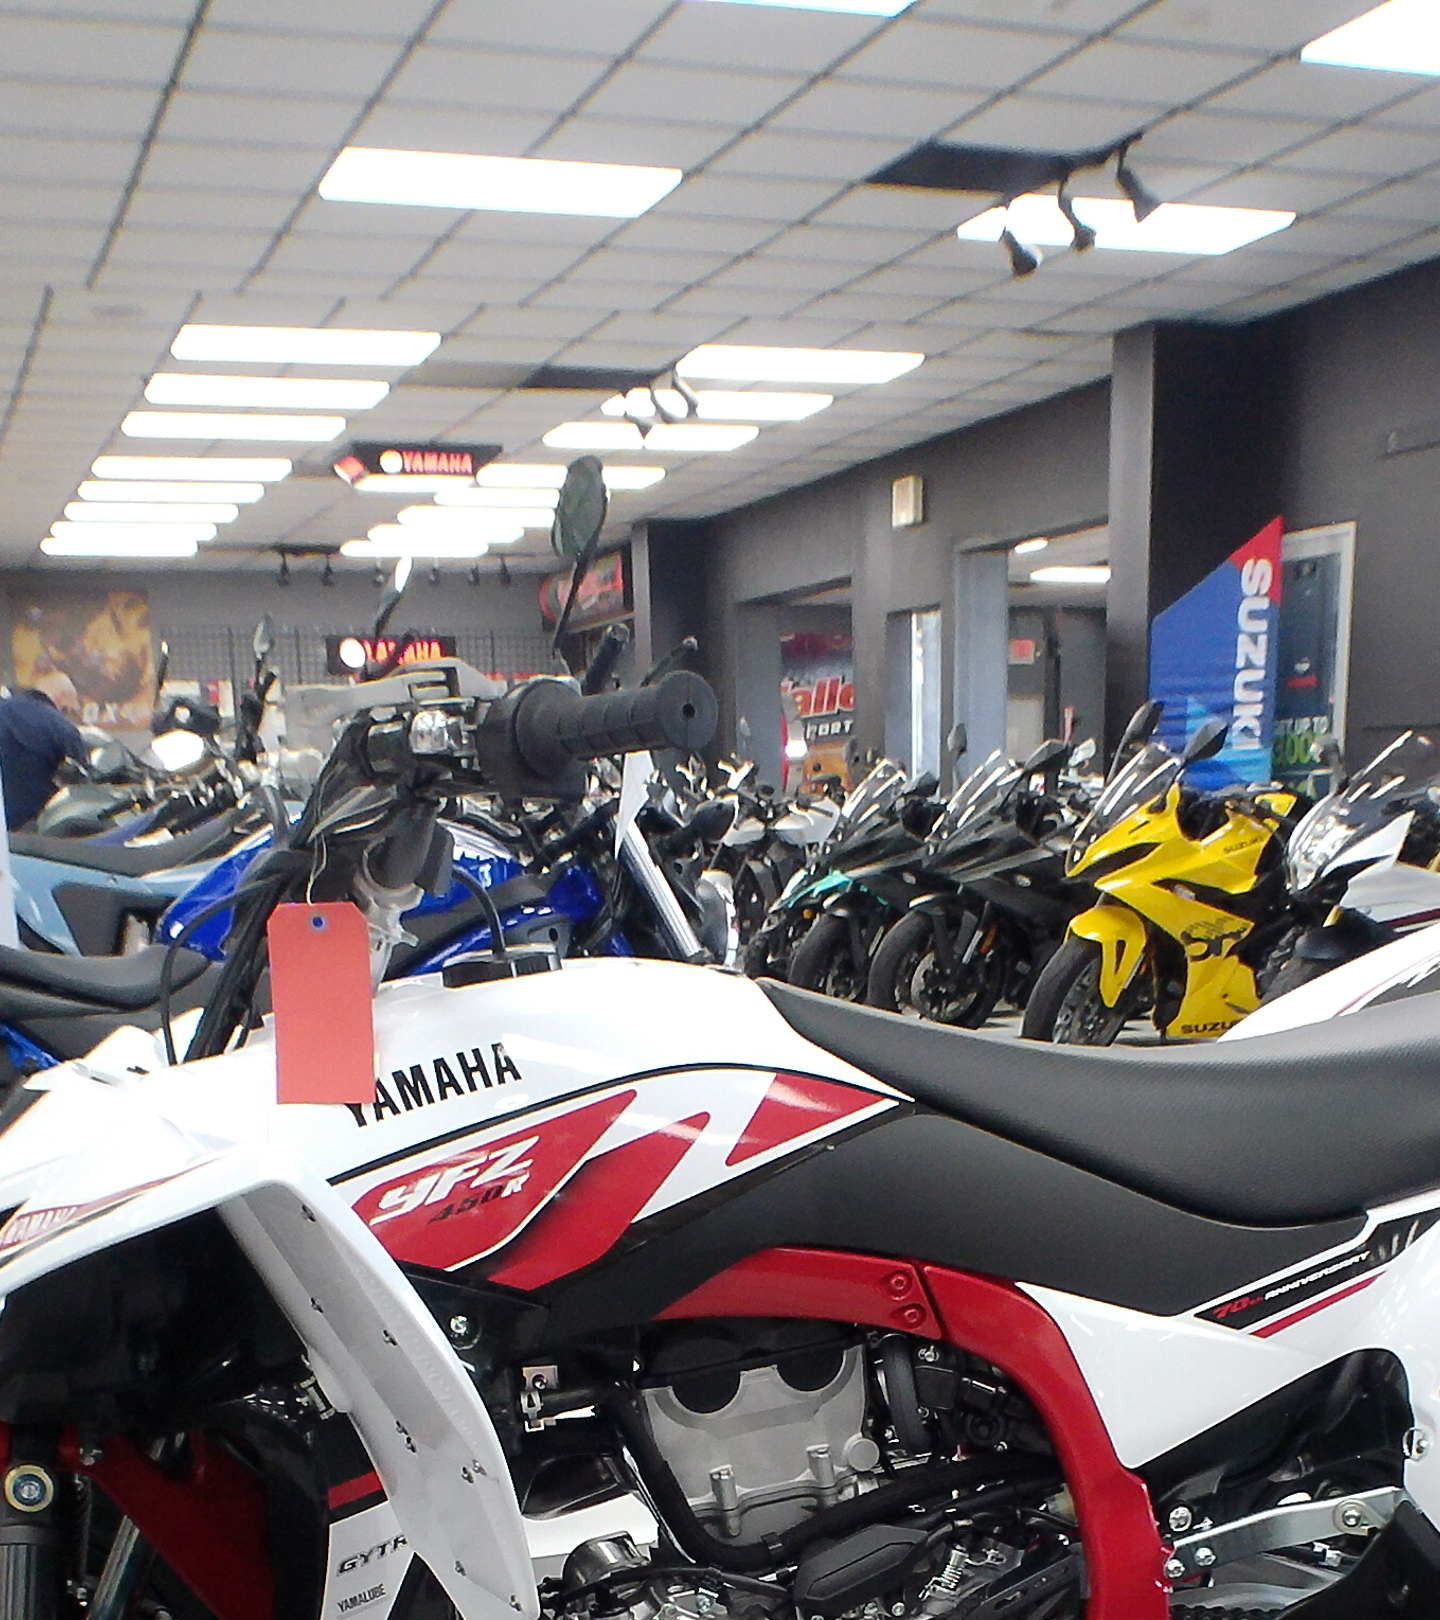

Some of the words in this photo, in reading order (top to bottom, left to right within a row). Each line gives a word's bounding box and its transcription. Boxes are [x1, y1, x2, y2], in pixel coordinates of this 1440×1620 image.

[402, 451, 473, 474] YAMAHA
[1232, 558, 1274, 750] SUZUKI
[1223, 836, 1263, 854] SUZUKI
[1180, 1019, 1240, 1035] SUZU
[369, 1135, 540, 1227] YFZ
[427, 1172, 531, 1225] 450R
[336, 1534, 408, 1577] GYTR
[337, 1583, 387, 1613] YAMALUBE
